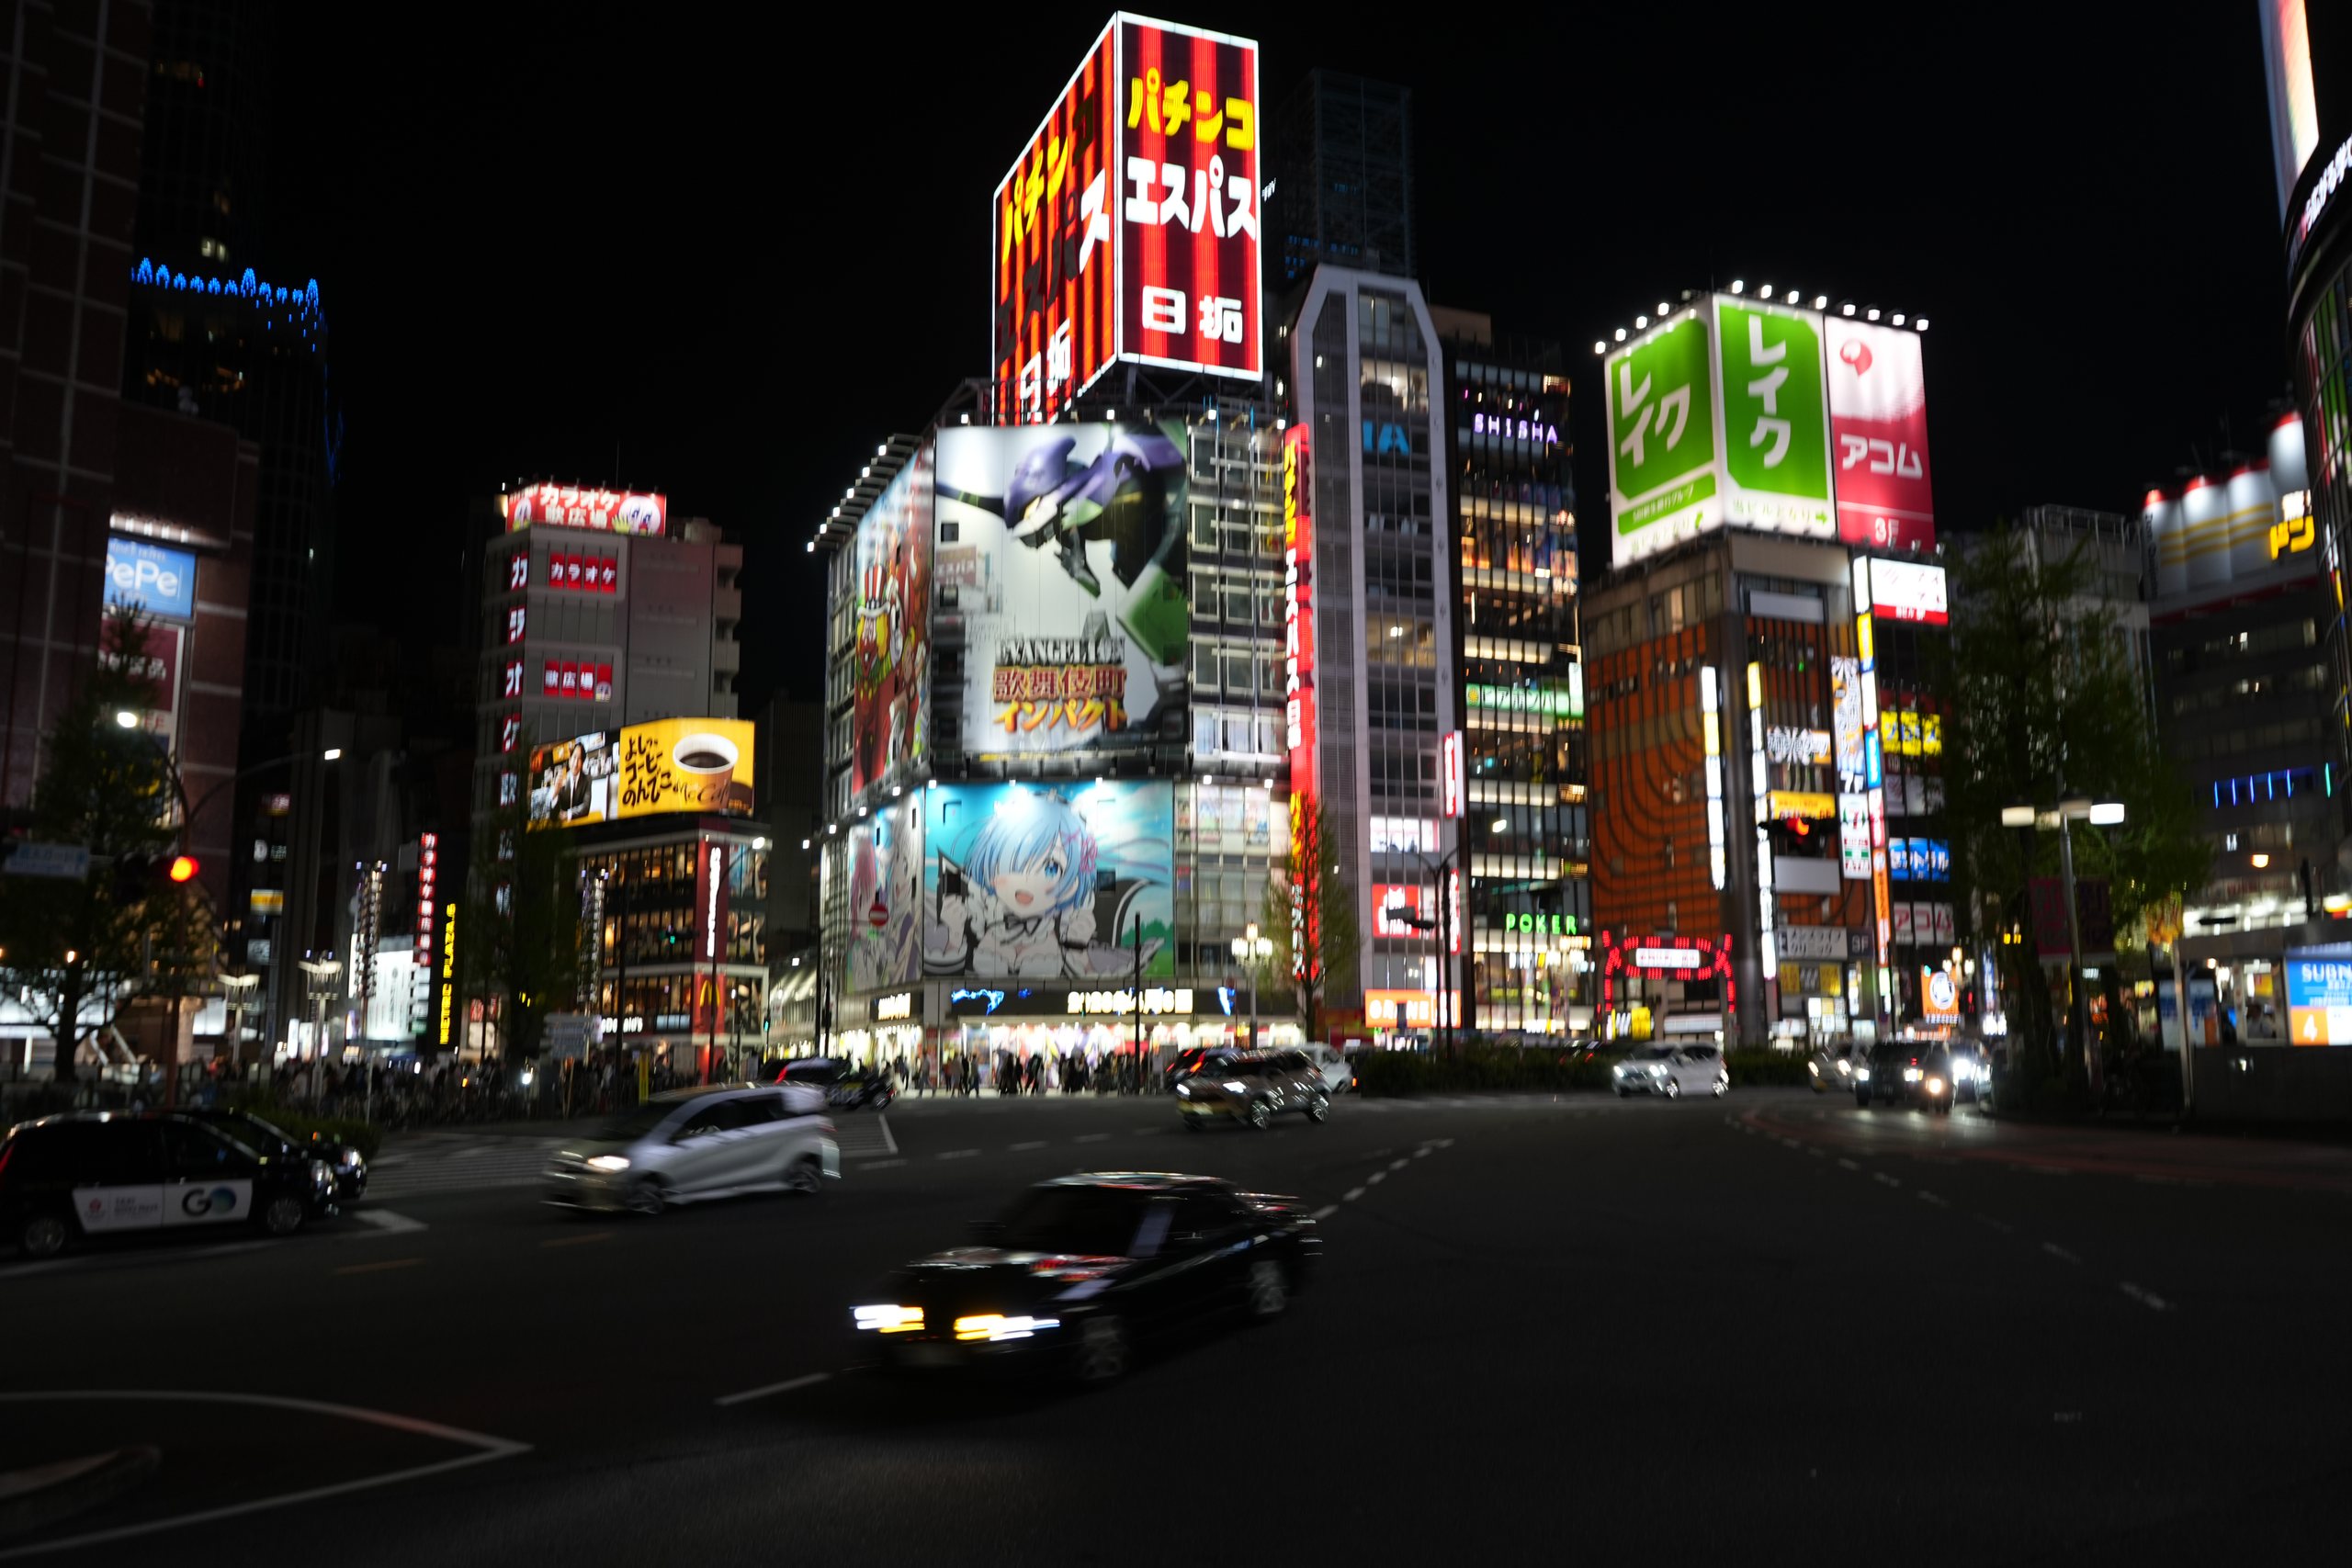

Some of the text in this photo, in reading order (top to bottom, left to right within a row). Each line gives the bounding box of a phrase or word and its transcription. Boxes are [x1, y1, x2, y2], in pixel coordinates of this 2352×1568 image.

[1128, 67, 1253, 151] パチンコ
[1125, 154, 1257, 241] エスパス
[1142, 285, 1243, 344] 日拓
[1747, 314, 1792, 469] レイク
[1475, 412, 1558, 445] SHISHA
[1620, 360, 1690, 468] レイク
[1840, 434, 1923, 479] アコム
[539, 485, 621, 512] カラオケ
[545, 504, 608, 529] 歌広場
[550, 559, 616, 584] カラオケ
[1286, 547, 1300, 693] エスパス
[994, 637, 1125, 664] EVANGELION
[545, 670, 594, 691] 歌広場
[993, 665, 1127, 701] 歌舞伎町
[993, 697, 1128, 732] インパクト
[626, 750, 663, 785] コーヒー
[1505, 912, 1577, 936] POKER
[1894, 904, 1953, 934] アコム
[2303, 1013, 2318, 1042] 4
